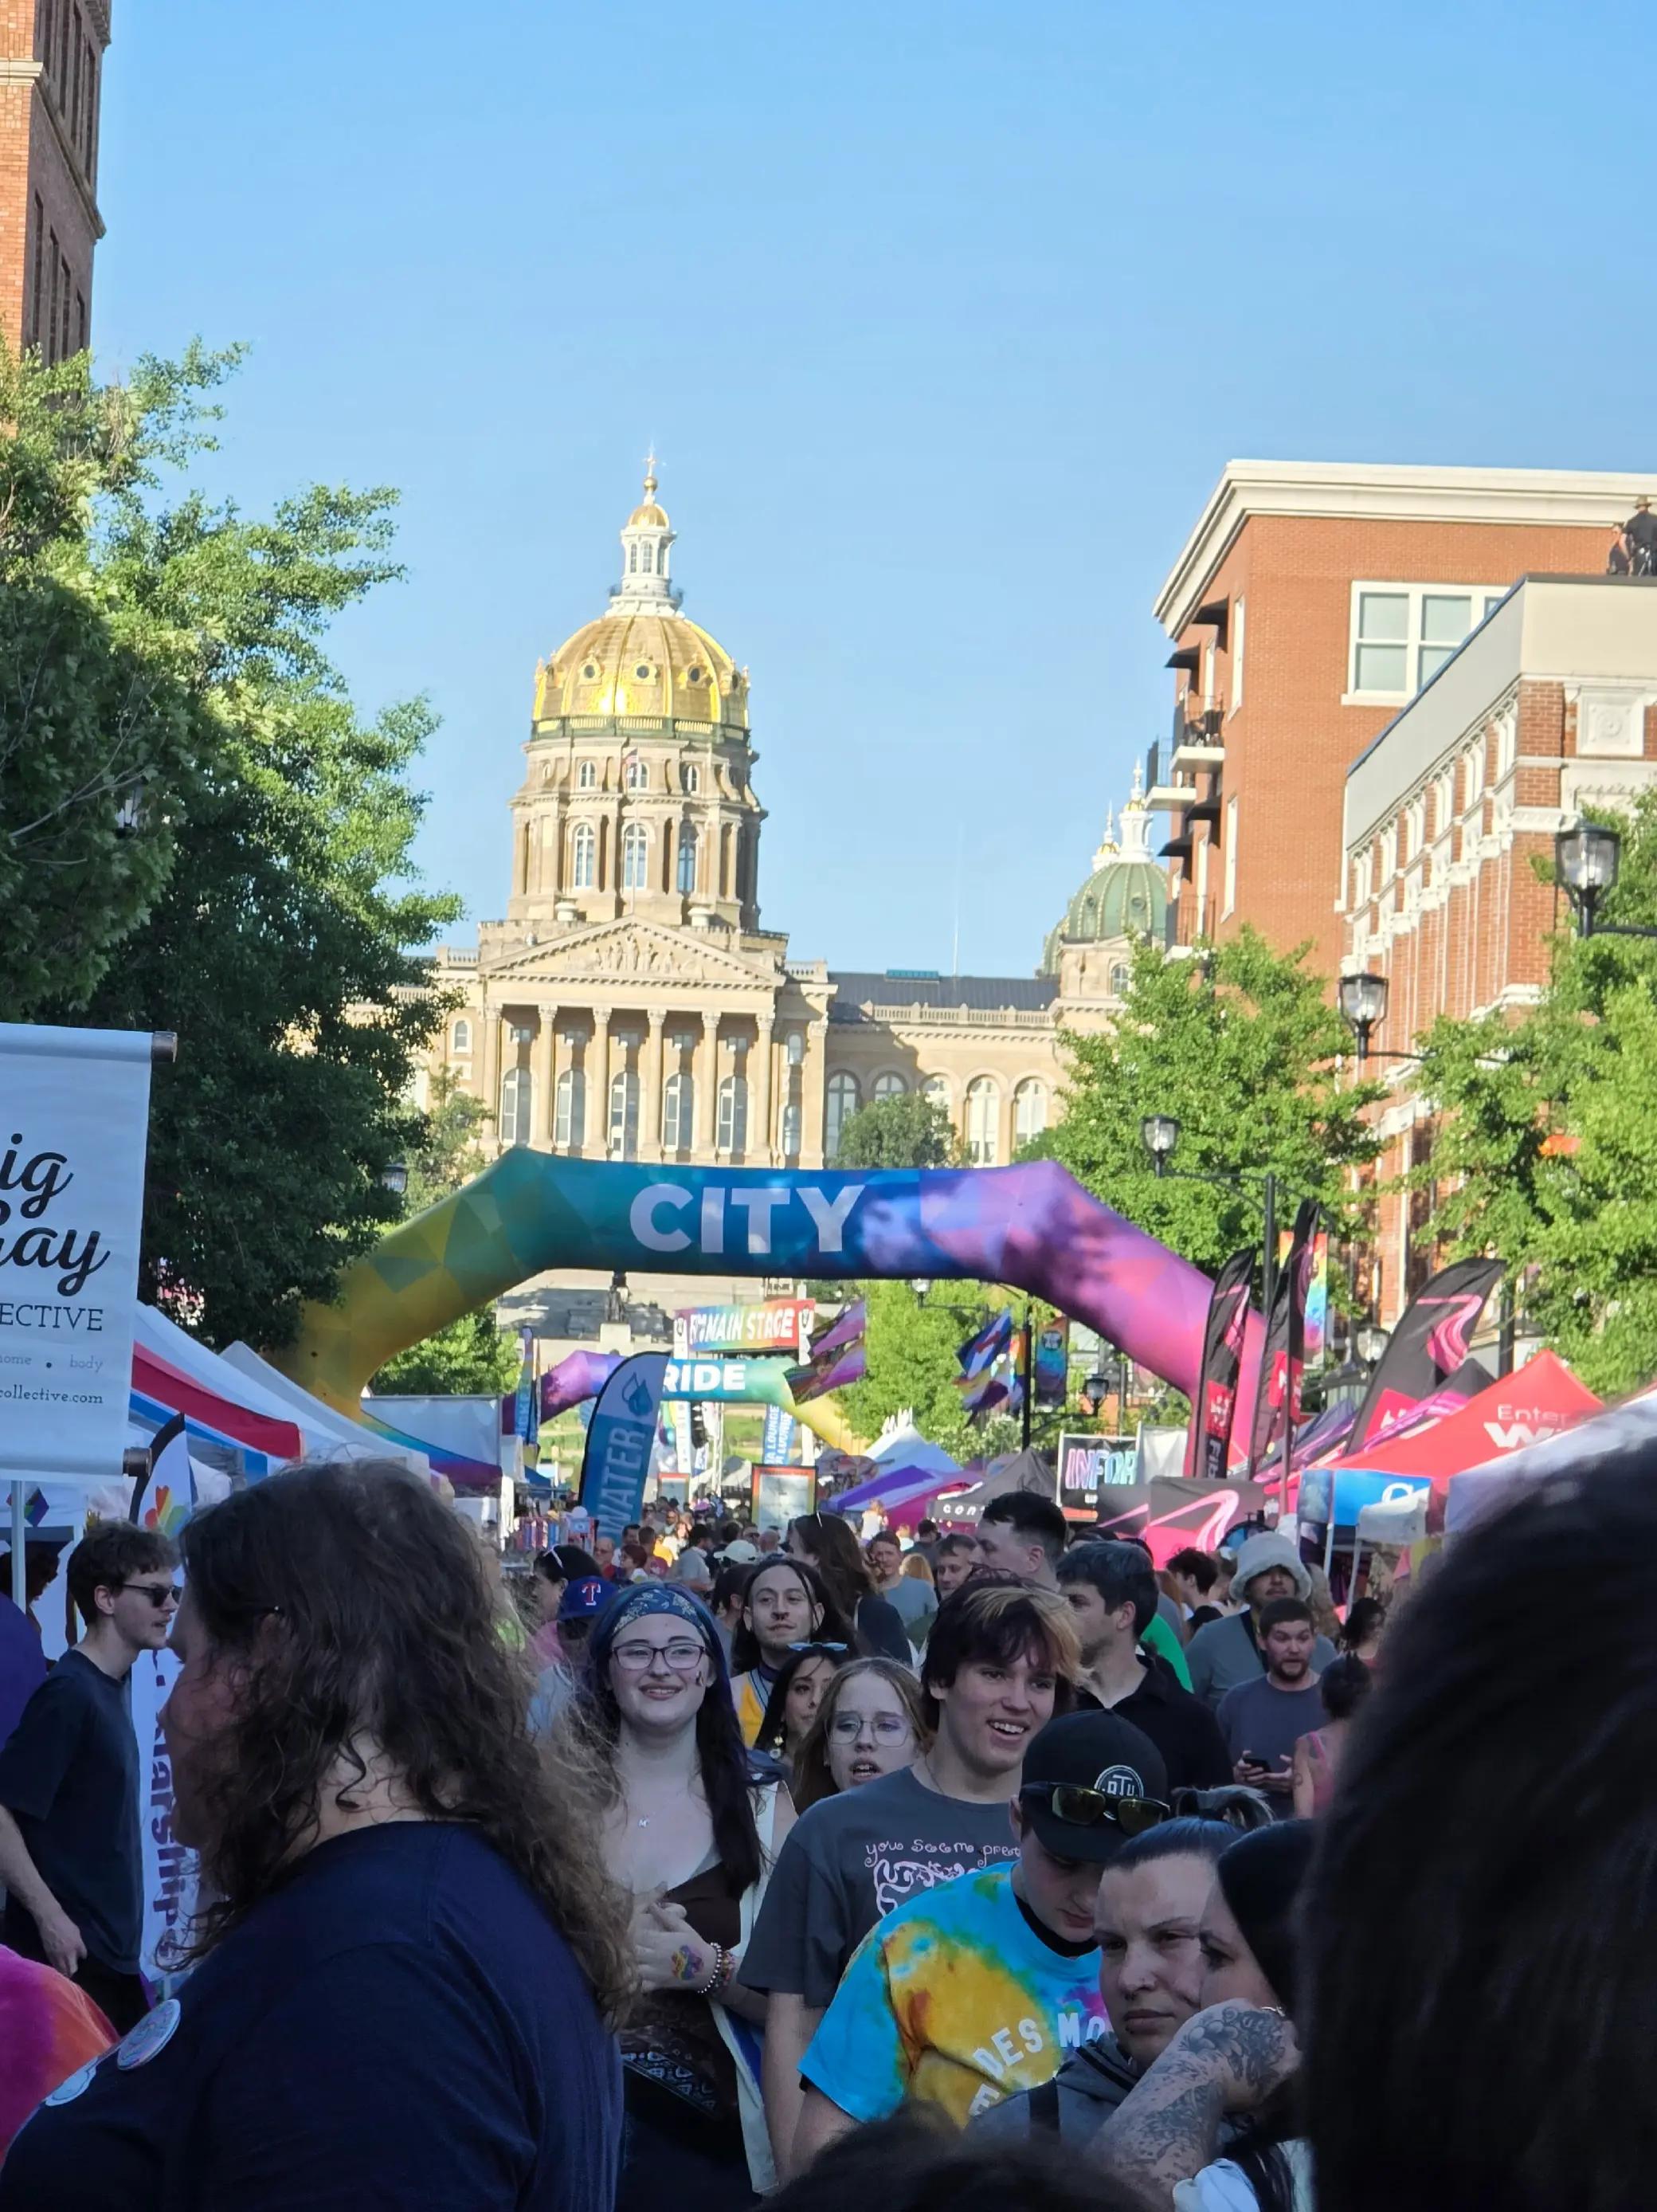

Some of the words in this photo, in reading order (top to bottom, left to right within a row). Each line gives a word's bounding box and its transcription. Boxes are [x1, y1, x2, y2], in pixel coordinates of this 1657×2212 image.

[629, 1182, 865, 1255] CITY
[0, 1199, 111, 1297] ay
[0, 1302, 104, 1332] ECTIVE
[746, 1308, 795, 1340] STAGE
[69, 1354, 104, 1374] body
[663, 1363, 746, 1393] RIDE
[597, 1427, 647, 1535] WATER
[1057, 2012, 1106, 2048] MO
